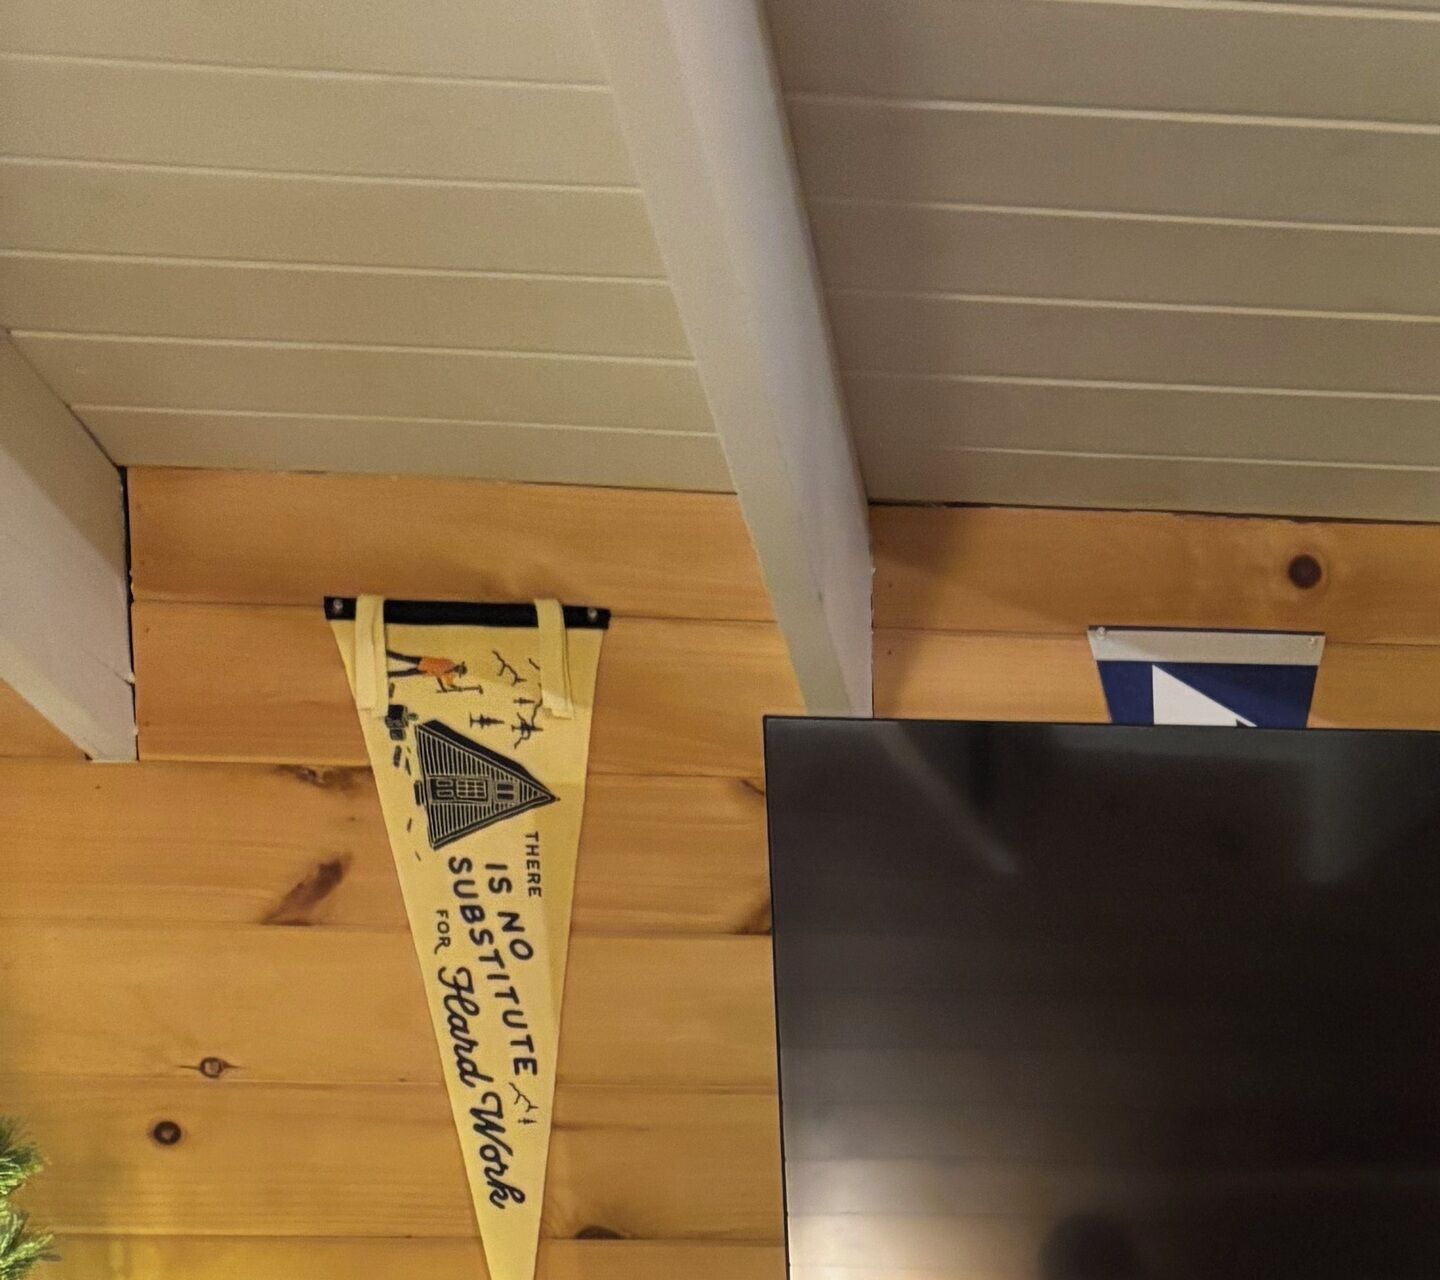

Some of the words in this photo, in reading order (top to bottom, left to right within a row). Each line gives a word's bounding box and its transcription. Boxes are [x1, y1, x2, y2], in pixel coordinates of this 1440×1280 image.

[485, 862, 512, 894] IS
[524, 831, 541, 898] THERE
[433, 909, 451, 955] FOR
[497, 911, 534, 961] NO
[448, 856, 537, 1077] SUBSTITUTE
[438, 966, 494, 1089] Hard
[470, 1091, 526, 1210] Work
